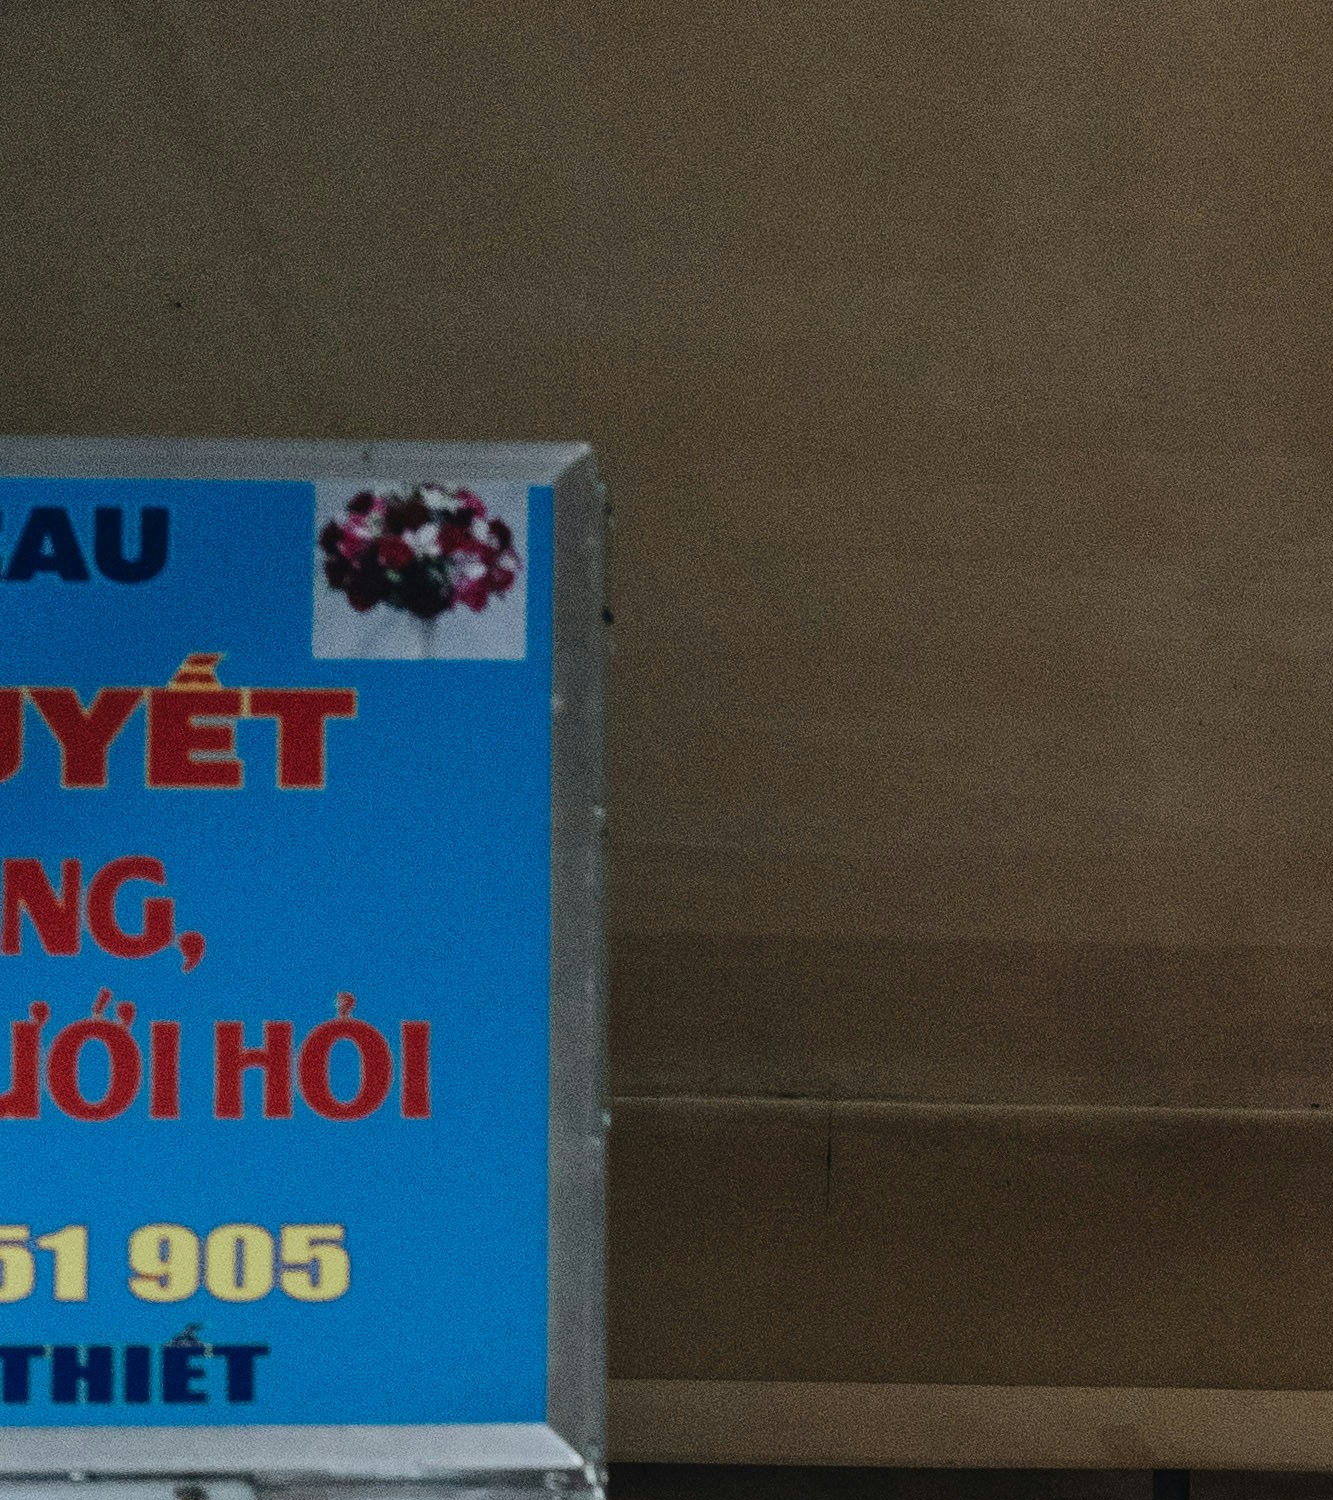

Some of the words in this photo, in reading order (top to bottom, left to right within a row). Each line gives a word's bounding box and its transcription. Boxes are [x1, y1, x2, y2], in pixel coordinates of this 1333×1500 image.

[0, 506, 170, 582] AU
[213, 992, 433, 1121] HỎI
[128, 1223, 351, 1302] 905
